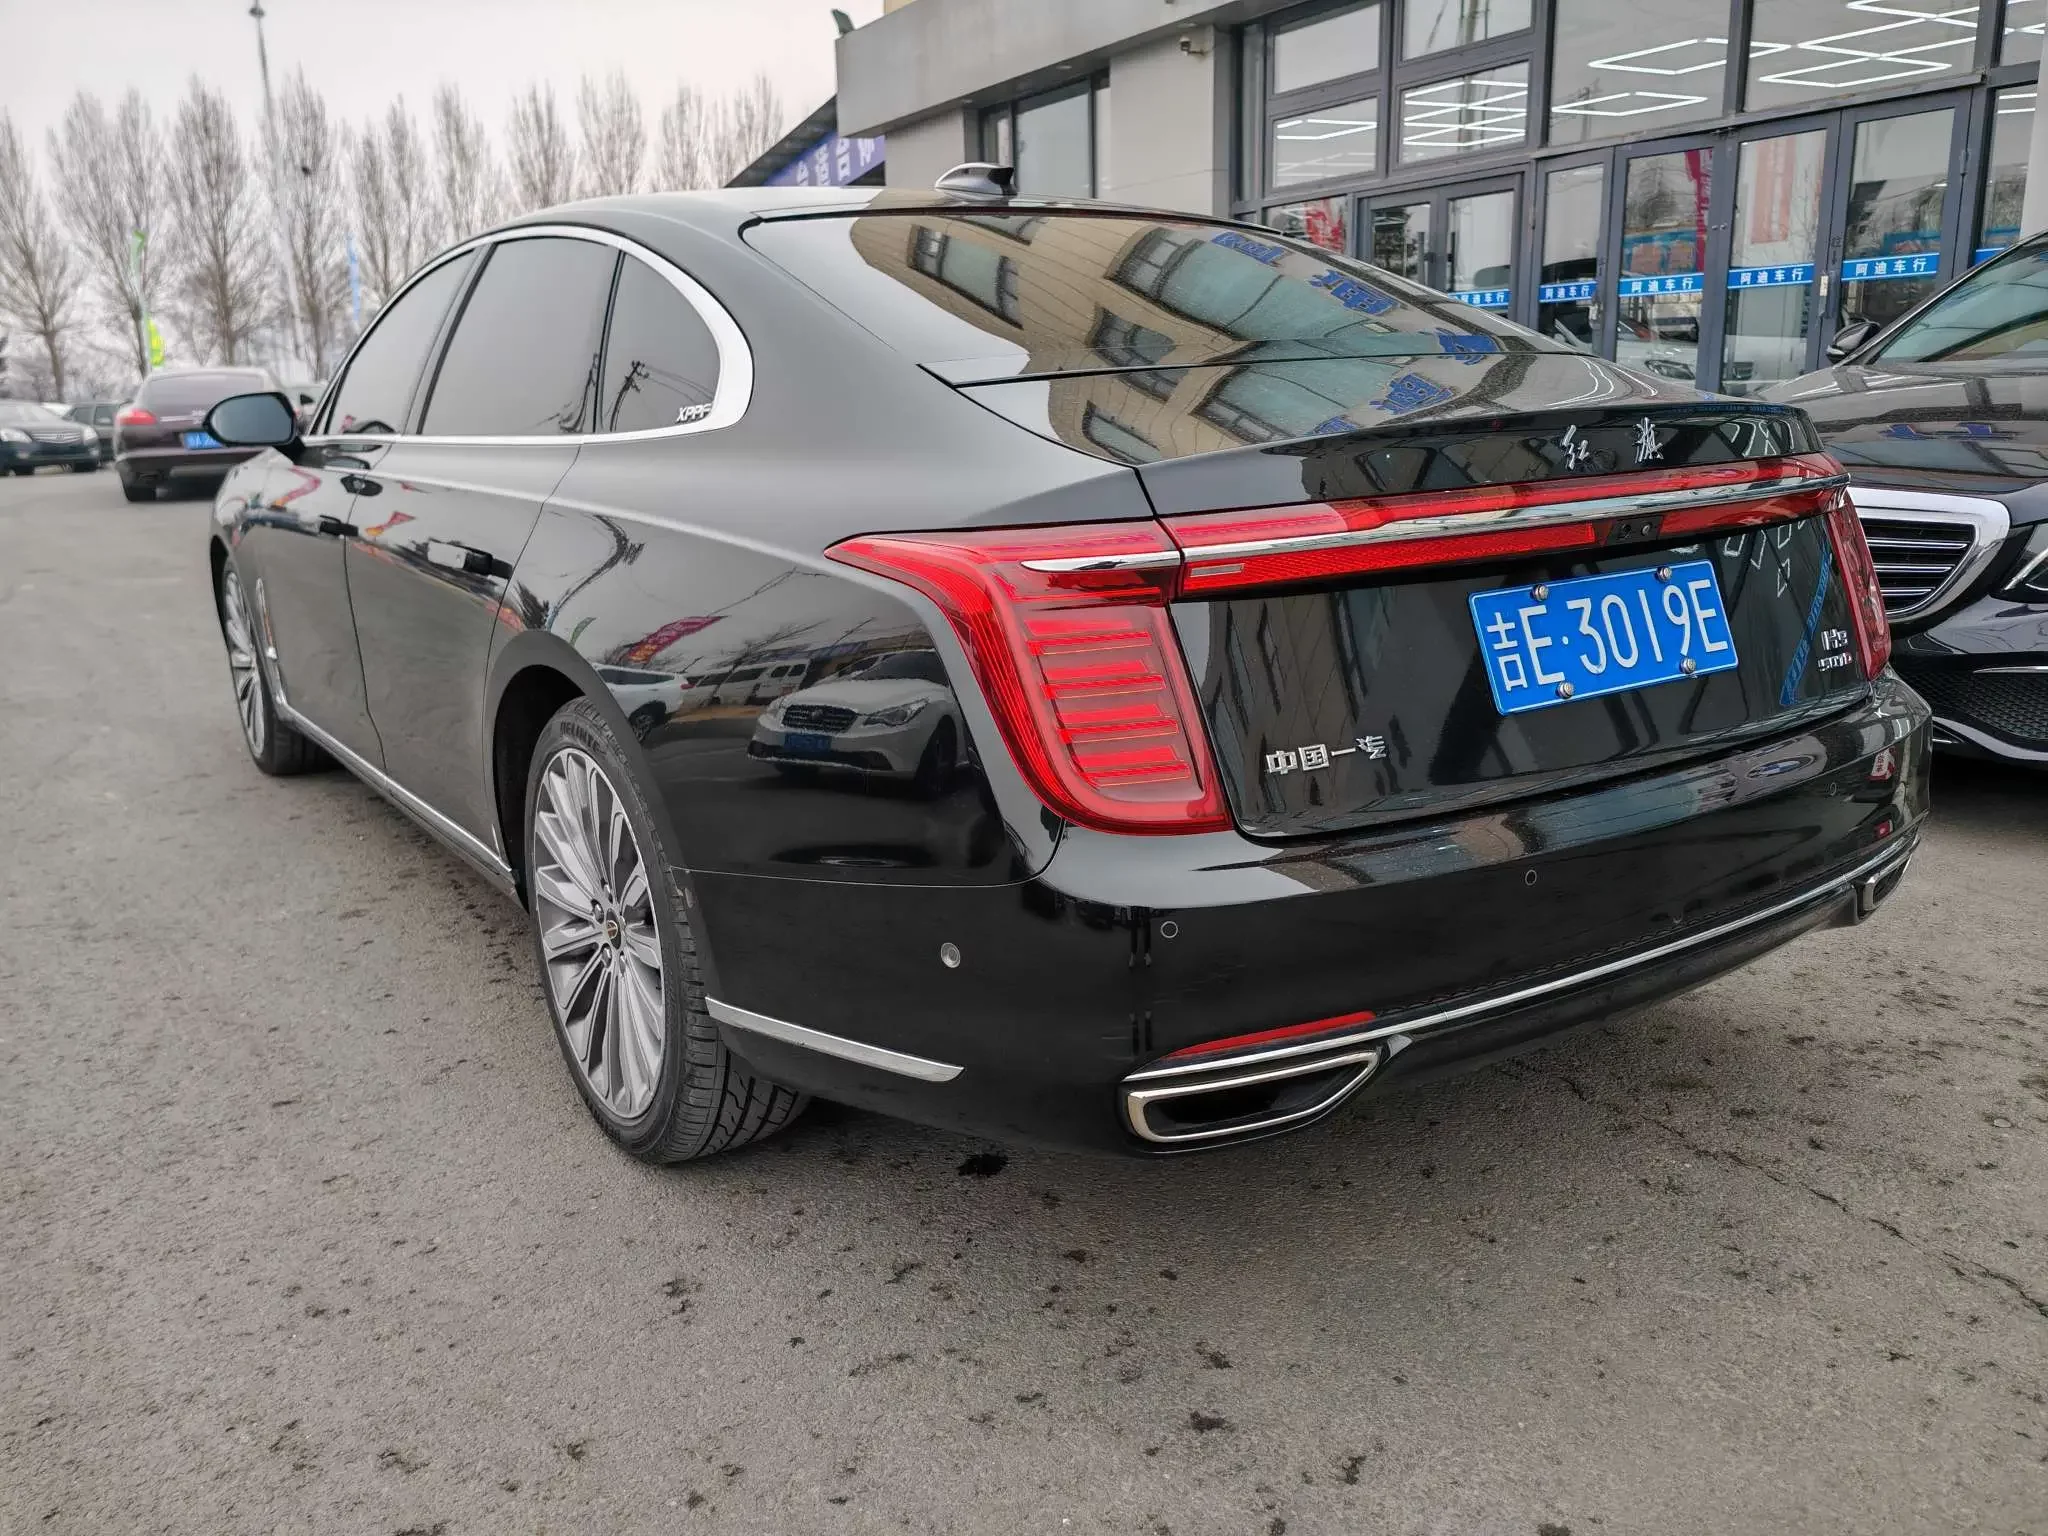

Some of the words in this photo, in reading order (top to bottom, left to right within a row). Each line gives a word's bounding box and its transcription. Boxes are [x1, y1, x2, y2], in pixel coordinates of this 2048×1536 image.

[1855, 256, 1928, 277] 阿迪车行
[1631, 277, 1694, 293] 阿迪车行
[1740, 267, 1804, 286] 阿迪车行
[676, 403, 712, 422] XPPF
[1486, 578, 1729, 692] 吉E·3019E
